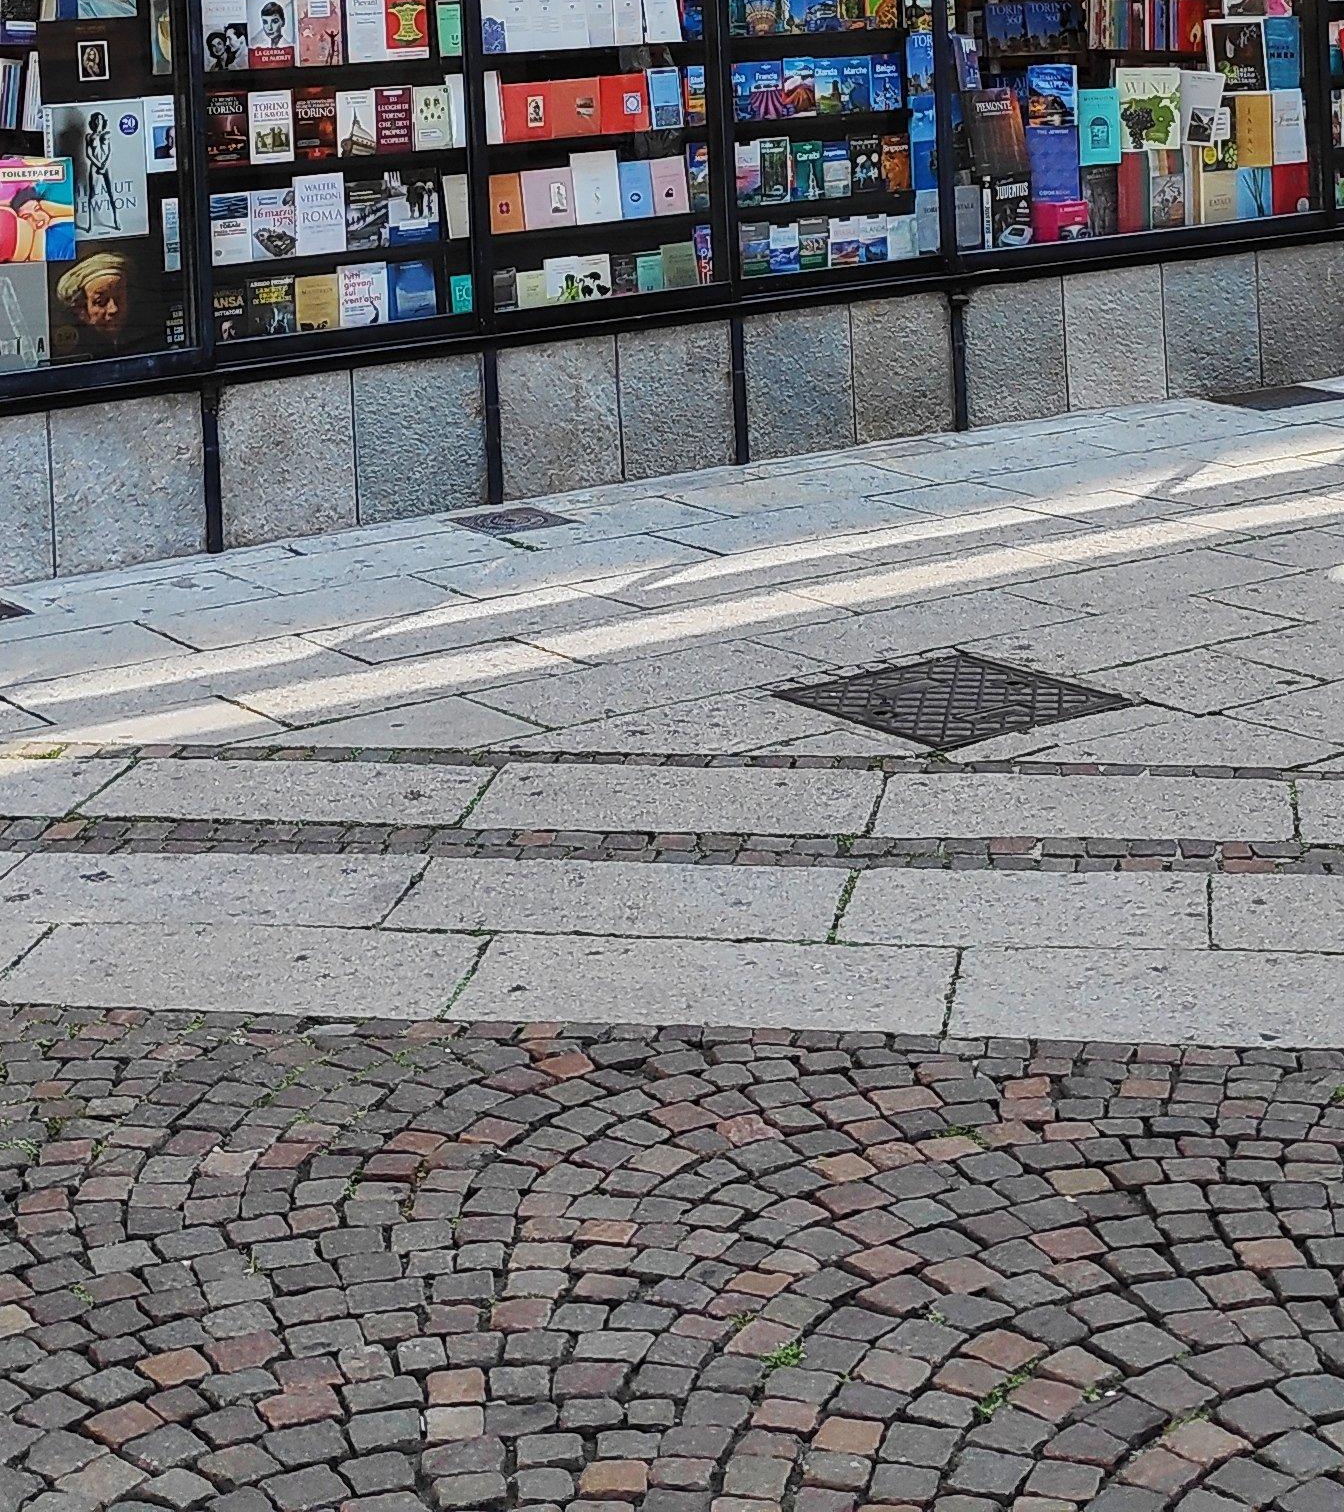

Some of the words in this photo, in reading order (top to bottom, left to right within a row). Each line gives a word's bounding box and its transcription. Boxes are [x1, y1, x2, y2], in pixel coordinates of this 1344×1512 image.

[1124, 81, 1172, 94] WINE
[207, 104, 243, 115] TORINO
[252, 102, 289, 112] TORINO
[296, 106, 335, 118] TORINO
[1, 168, 60, 179] TOILETPAPER
[304, 182, 338, 192] WALTER
[253, 208, 263, 219] 16
[302, 209, 343, 223] ROMA
